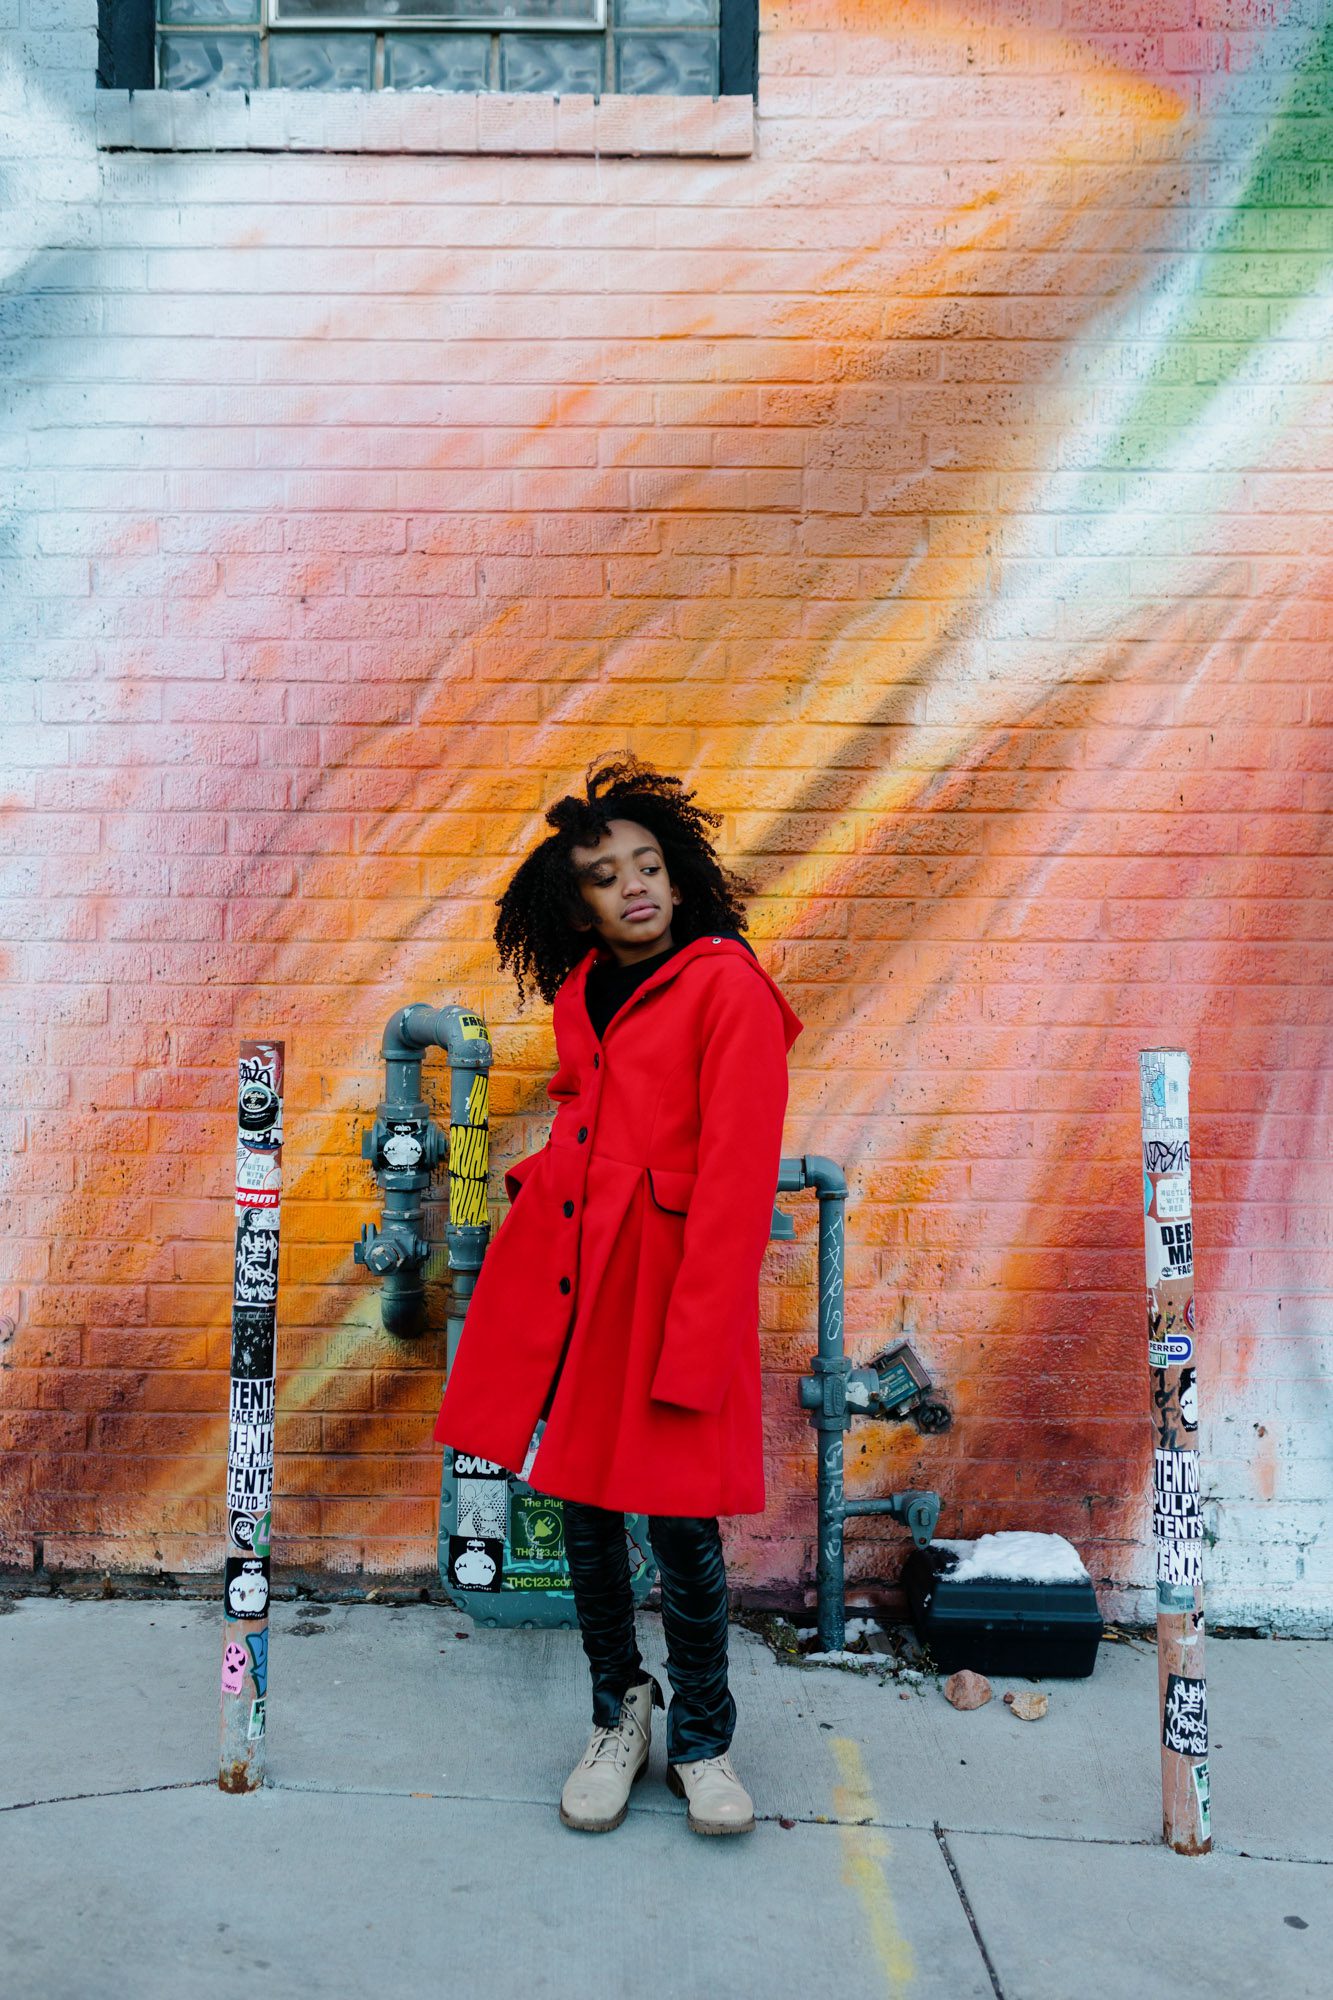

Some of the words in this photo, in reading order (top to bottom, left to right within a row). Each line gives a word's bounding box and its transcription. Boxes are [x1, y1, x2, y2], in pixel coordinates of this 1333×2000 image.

[236, 1191, 277, 1204] RAM
[1149, 1342, 1183, 1353] PERREO
[231, 1409, 253, 1423] FACE
[228, 1492, 272, 1511] OVID-1
[521, 1498, 541, 1508] The
[1154, 1490, 1200, 1516] PULPY
